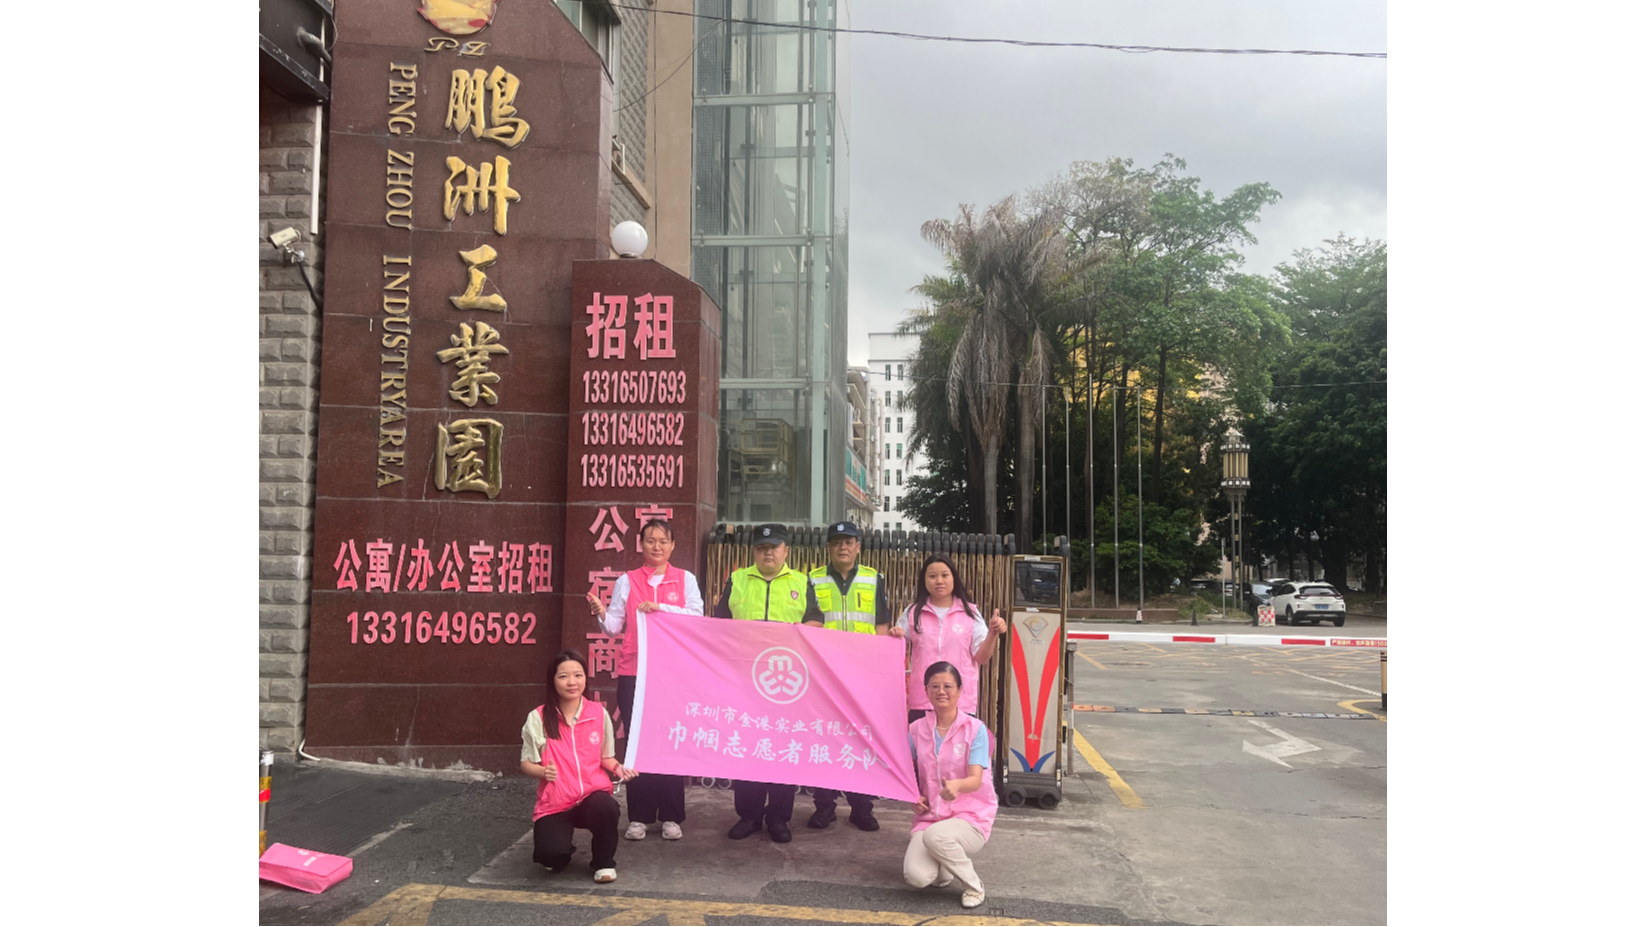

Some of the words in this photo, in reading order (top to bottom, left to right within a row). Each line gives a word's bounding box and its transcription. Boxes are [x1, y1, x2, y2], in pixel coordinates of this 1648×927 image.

[389, 62, 417, 136] PENG
[385, 148, 415, 230] ZHOU
[585, 291, 676, 361] 招租
[582, 370, 686, 404] 13316507693
[581, 412, 684, 446] 13316496582
[580, 453, 683, 488] 13316535691
[333, 538, 553, 594] 公寓/办公室招租
[347, 611, 537, 645] 13316496582
[685, 702, 873, 741] 深圳市金港实业有限公司
[668, 720, 891, 771] 巾帼志愿者服务队
